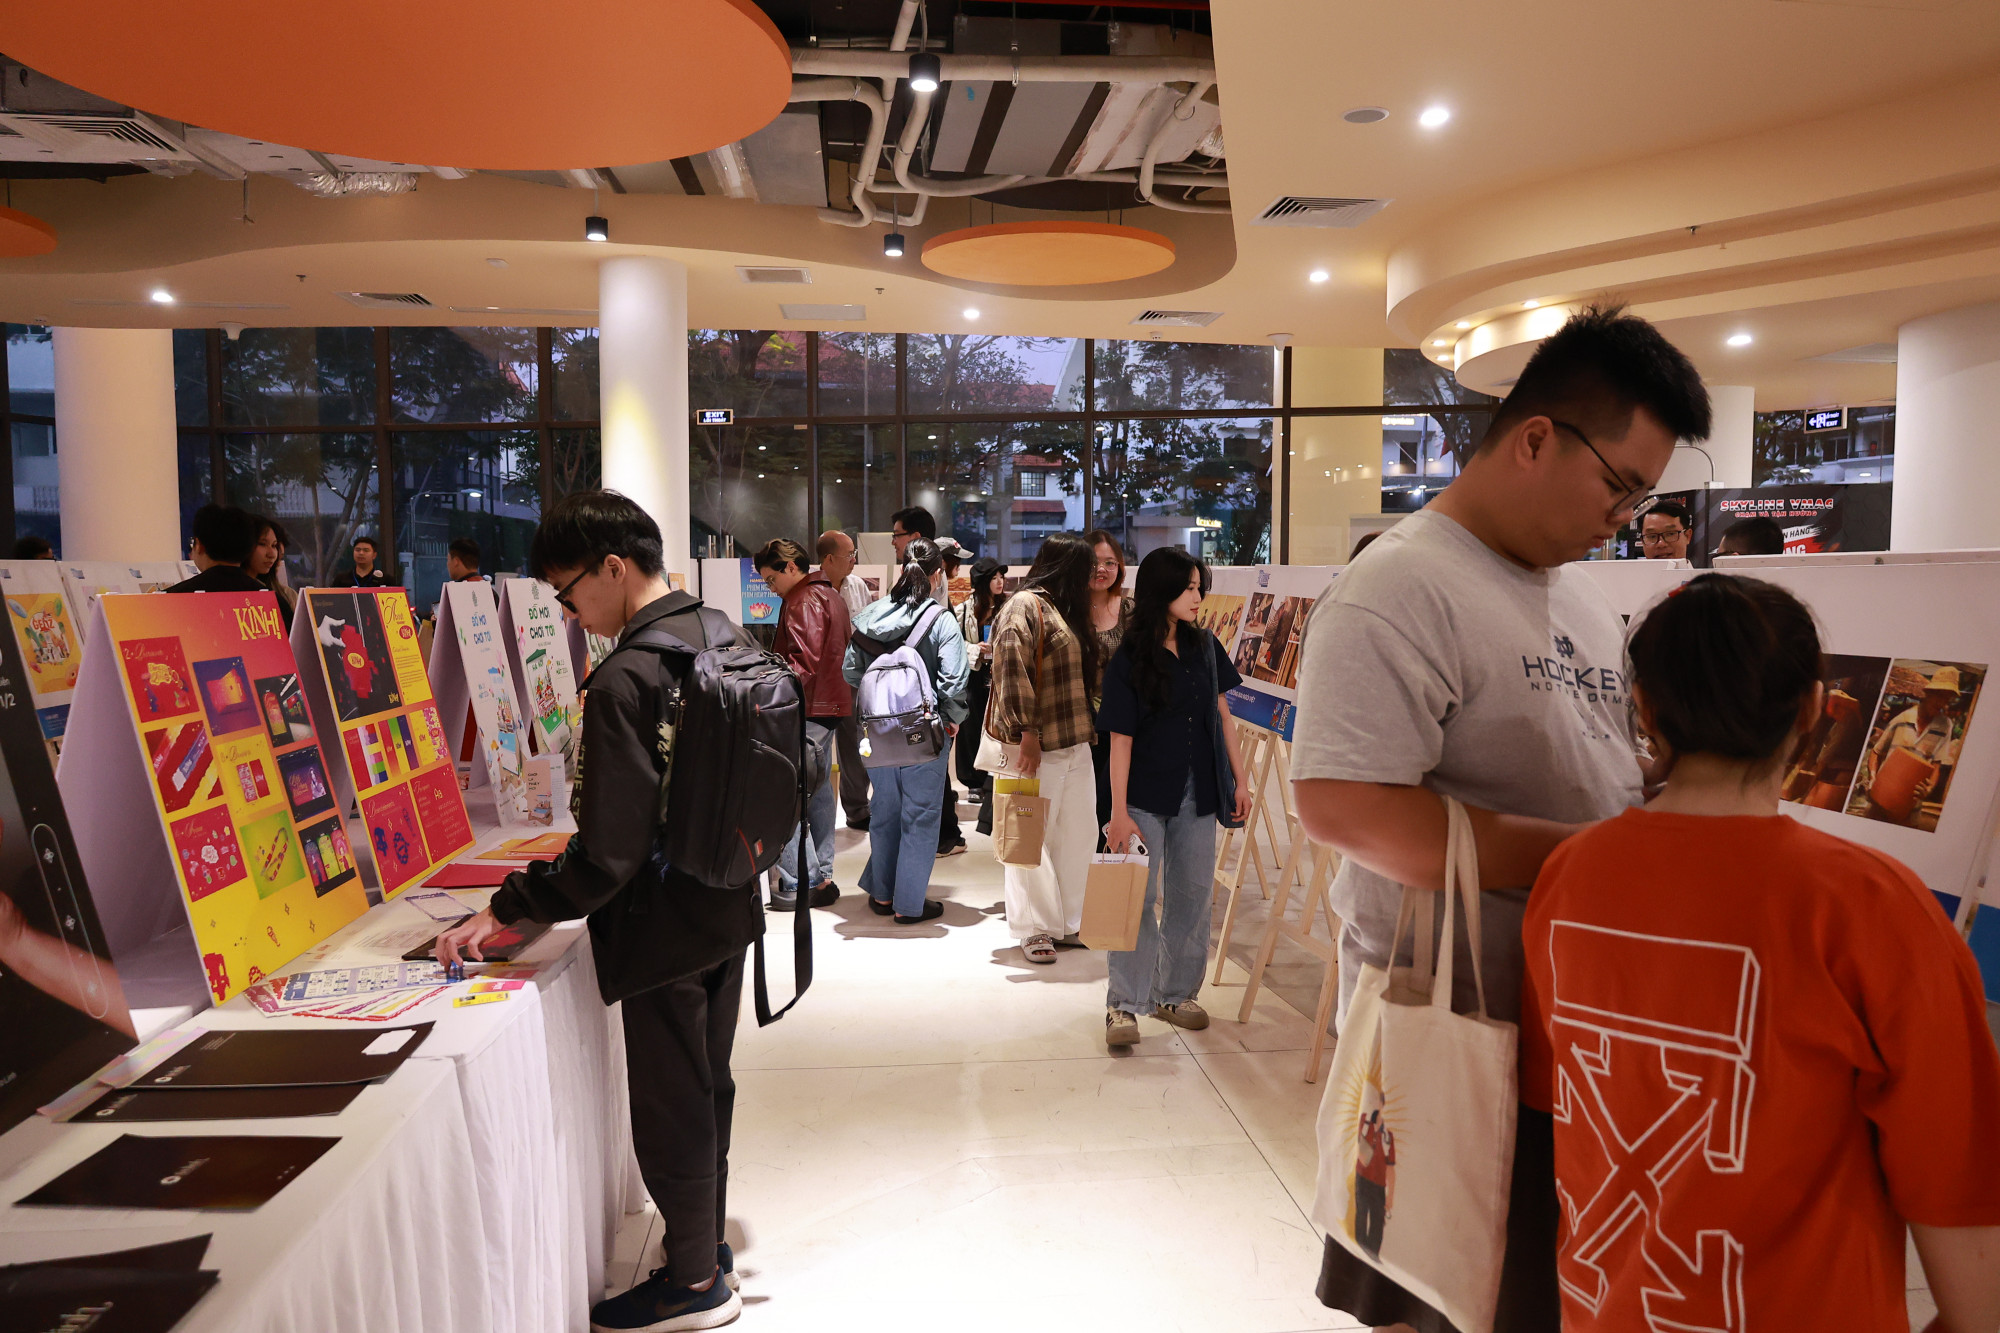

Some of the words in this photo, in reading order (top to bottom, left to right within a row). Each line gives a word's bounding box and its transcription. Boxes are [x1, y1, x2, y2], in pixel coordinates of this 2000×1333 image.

[1719, 499, 1785, 512] SKYLINE
[1789, 526, 1811, 537] HÀNG
[1530, 681, 1580, 699] NOTE
